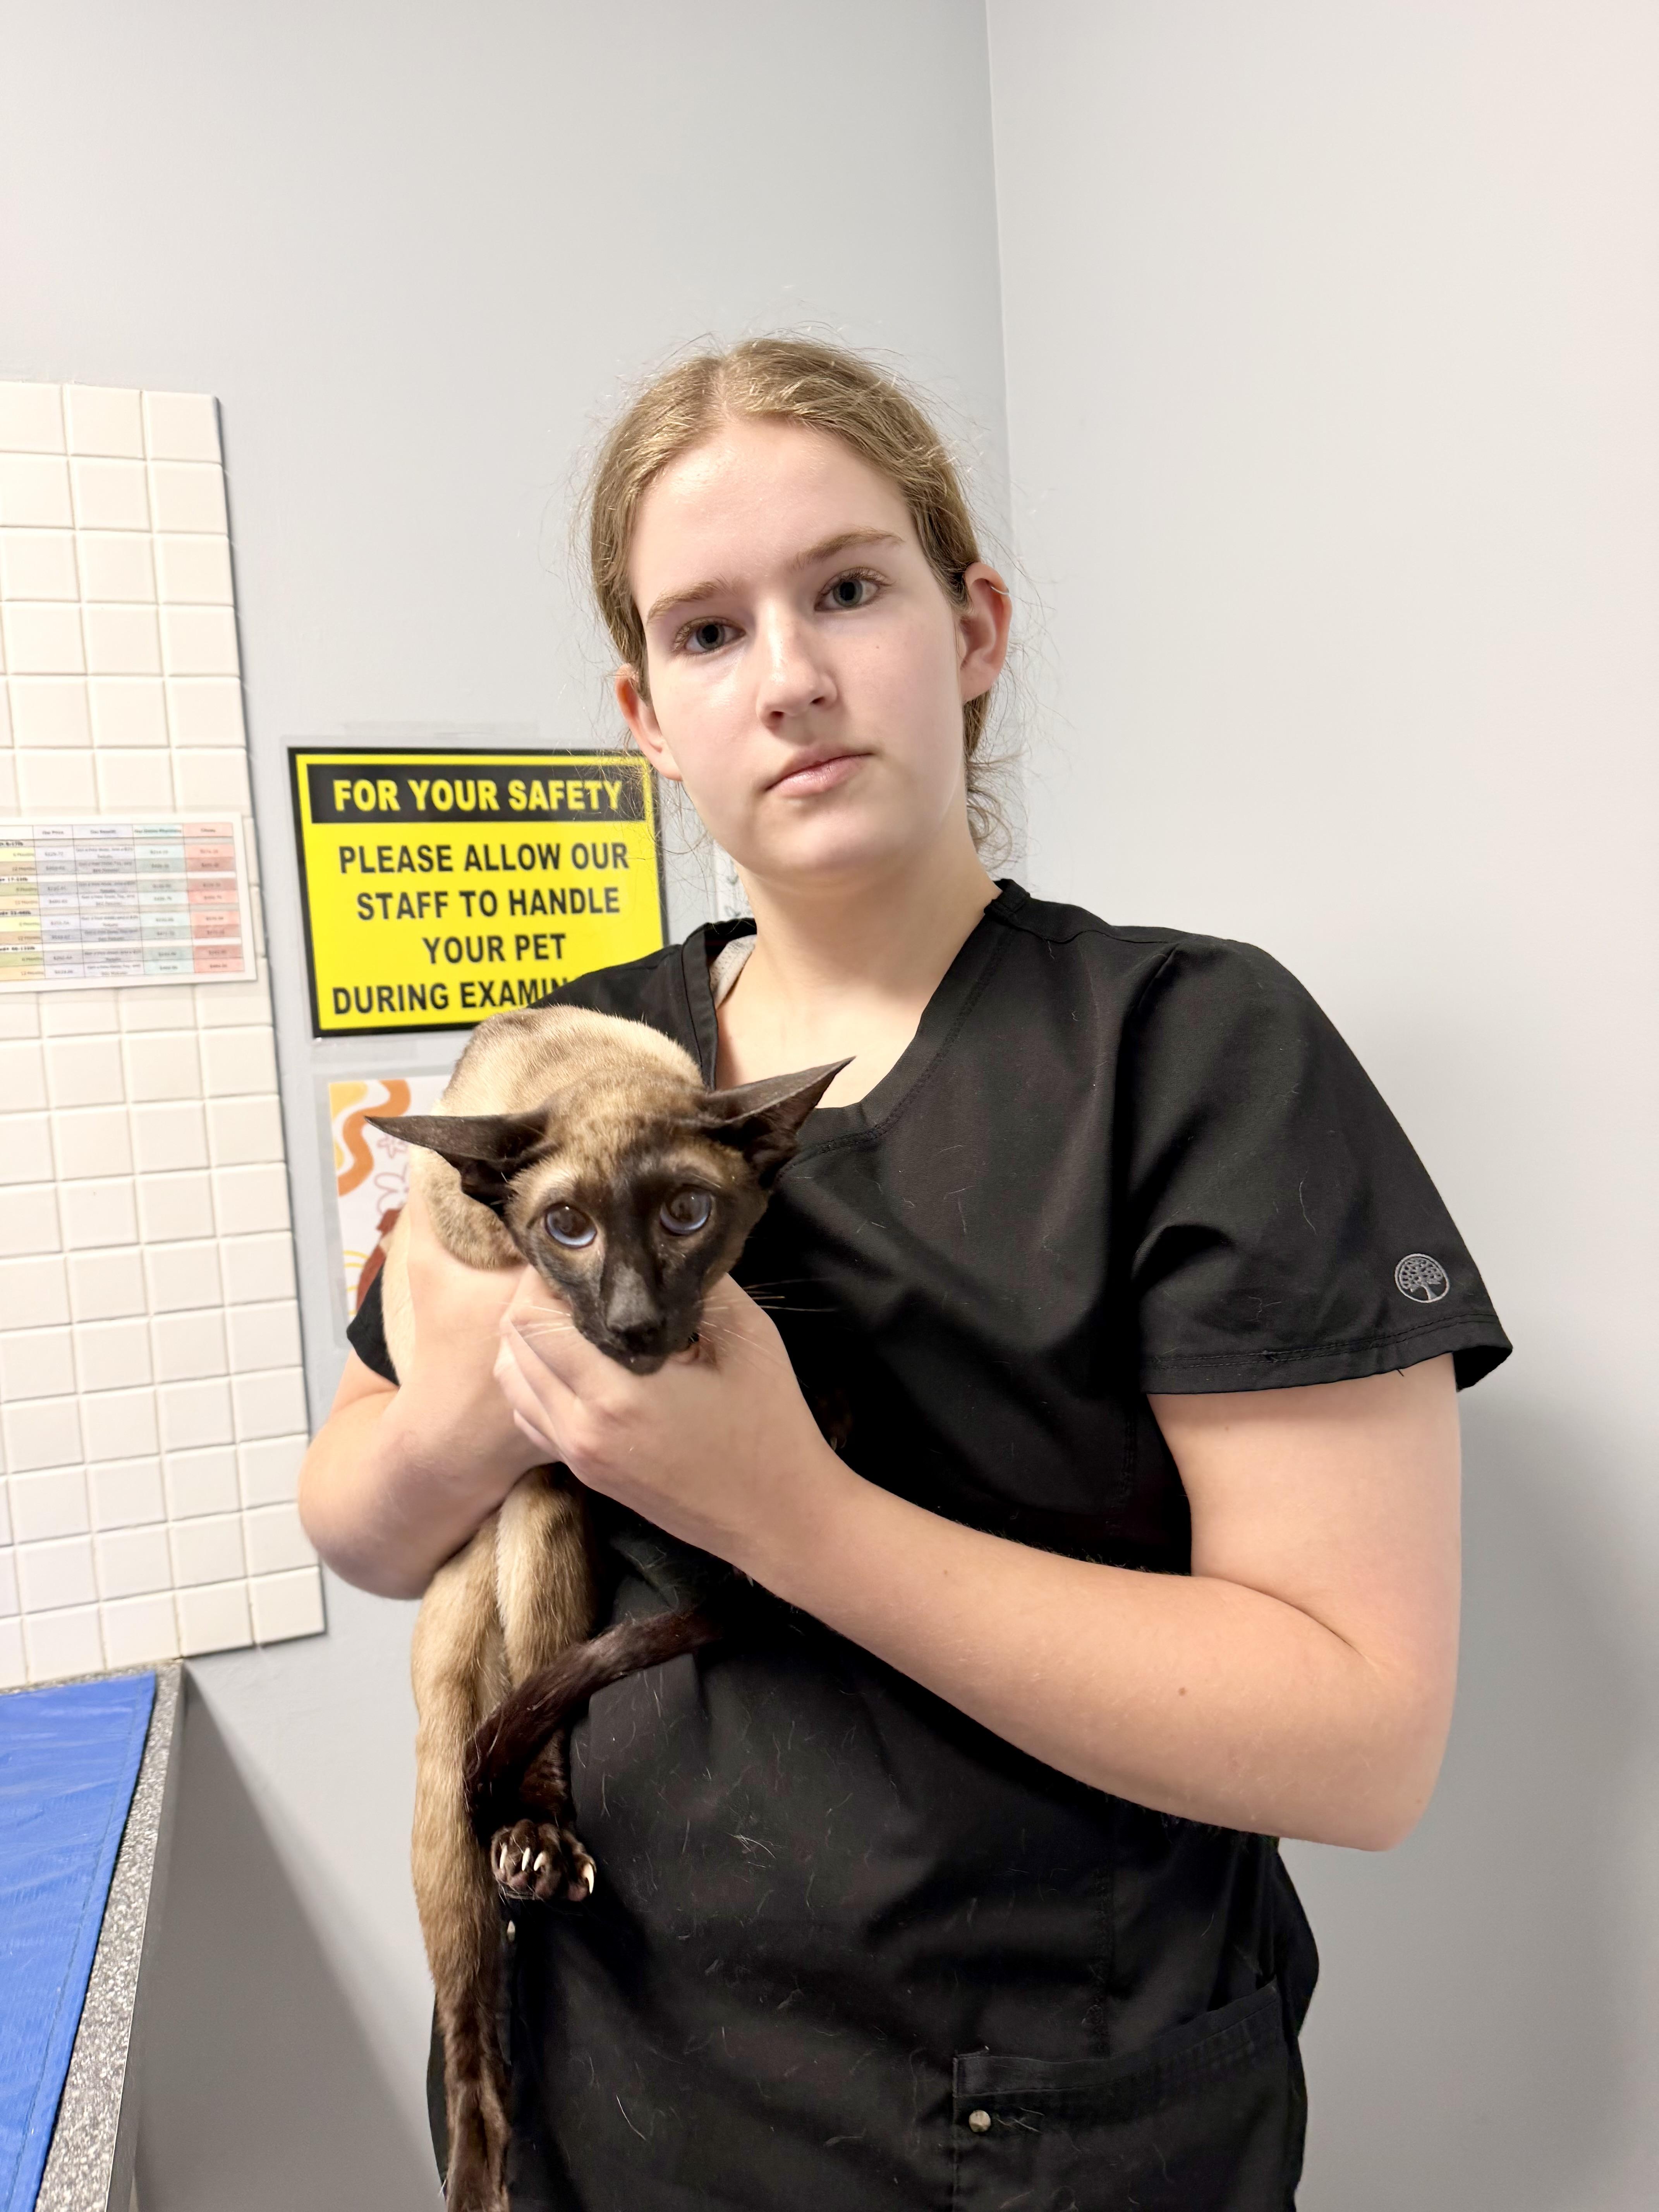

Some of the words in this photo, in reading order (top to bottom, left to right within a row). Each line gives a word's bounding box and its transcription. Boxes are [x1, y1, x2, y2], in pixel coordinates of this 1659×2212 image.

[333, 779, 401, 812] FOR
[407, 779, 500, 811] YOUR
[507, 779, 623, 811] SAFETY
[339, 845, 454, 874] PLEASE
[464, 843, 561, 872] ALLOW
[571, 842, 629, 870] OUR
[357, 891, 448, 921] STAFF
[459, 890, 498, 918] TO
[508, 887, 620, 917] HANDLE
[422, 935, 506, 965] YOUR
[514, 933, 567, 962] PET
[332, 982, 449, 1015] DURING
